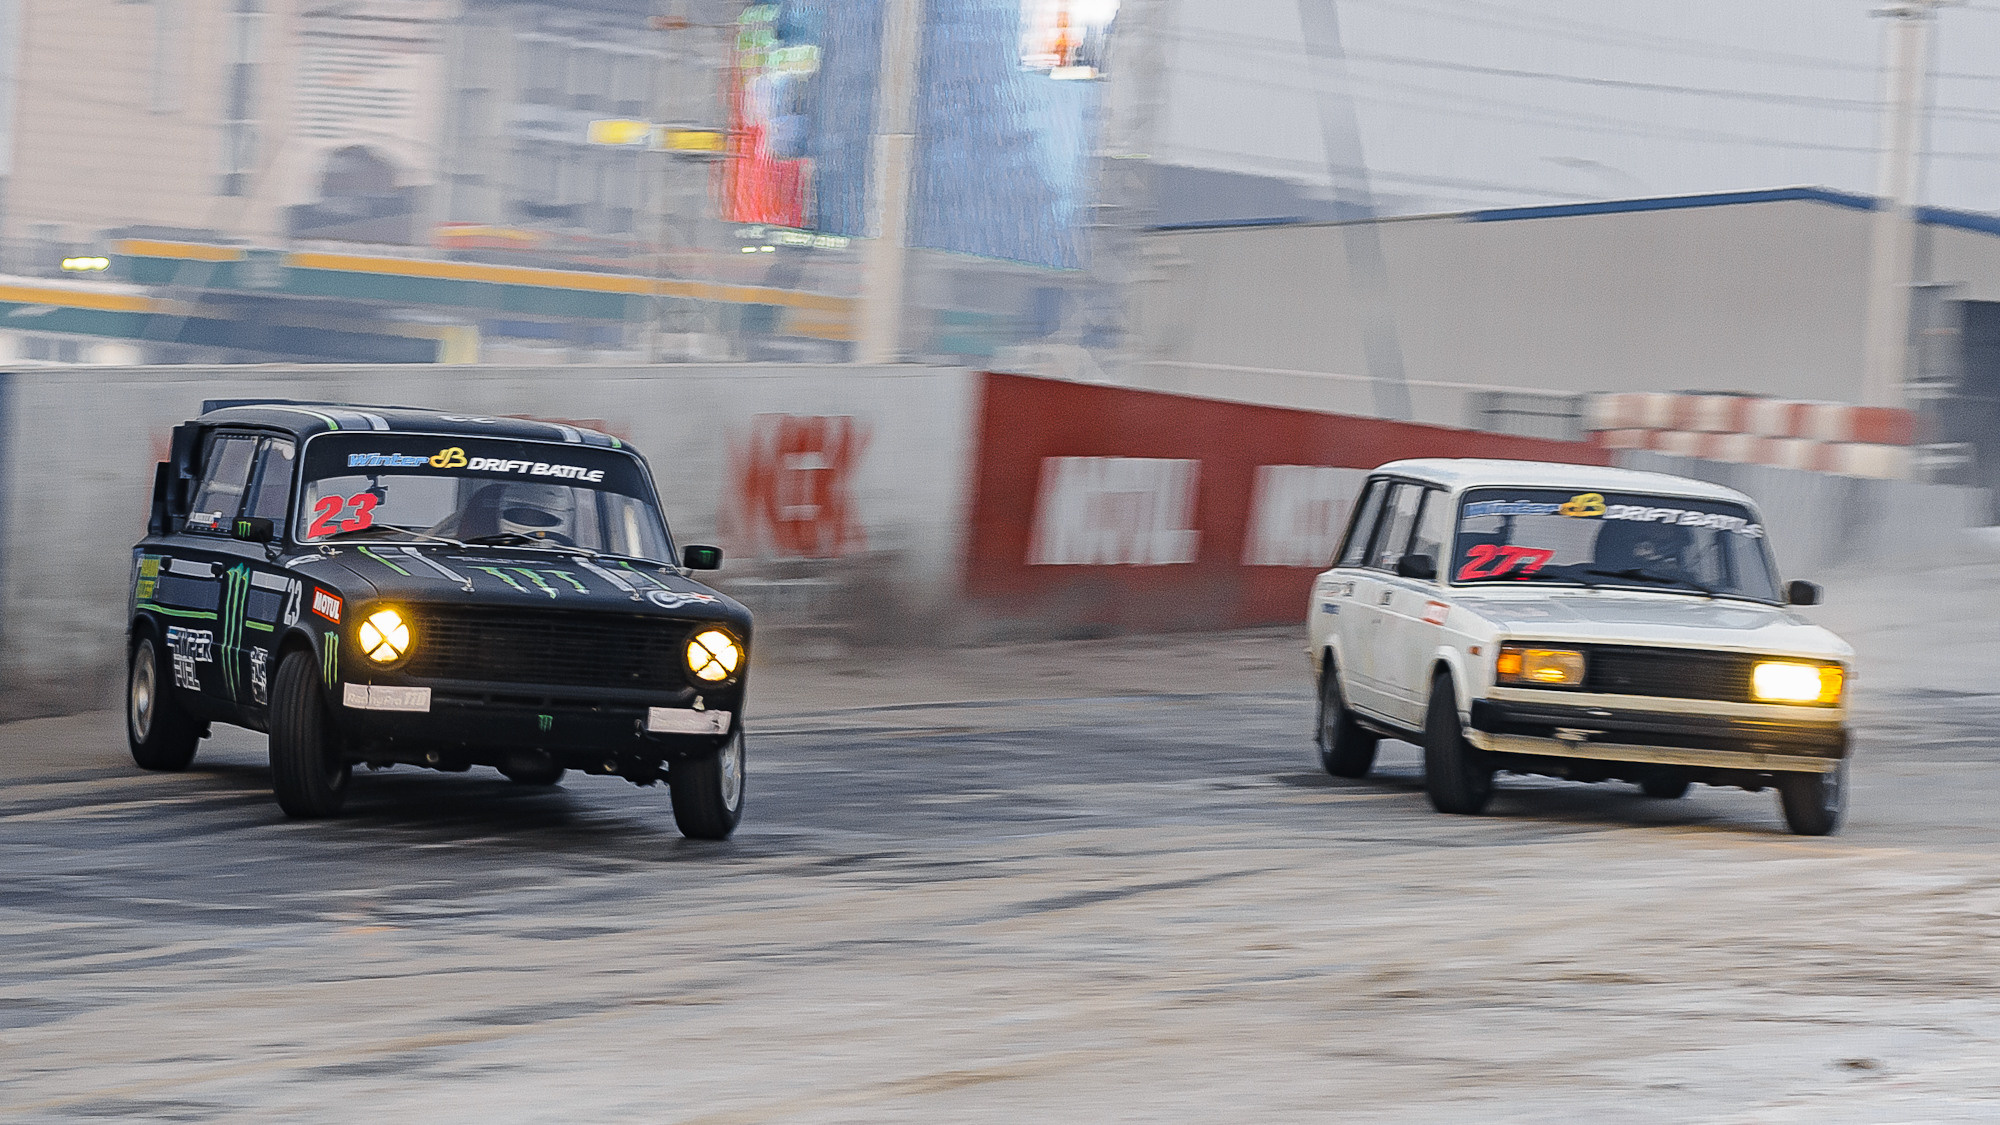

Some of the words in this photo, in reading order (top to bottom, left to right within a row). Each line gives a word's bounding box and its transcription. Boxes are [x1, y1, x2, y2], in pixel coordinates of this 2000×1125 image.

[348, 453, 430, 468] Winter
[467, 457, 534, 474] DRIFT
[530, 462, 605, 482] BATTLE
[307, 493, 378, 539] 23
[1602, 505, 1686, 524] DRIFT
[284, 578, 302, 627] 23
[313, 590, 340, 620] MOTUL
